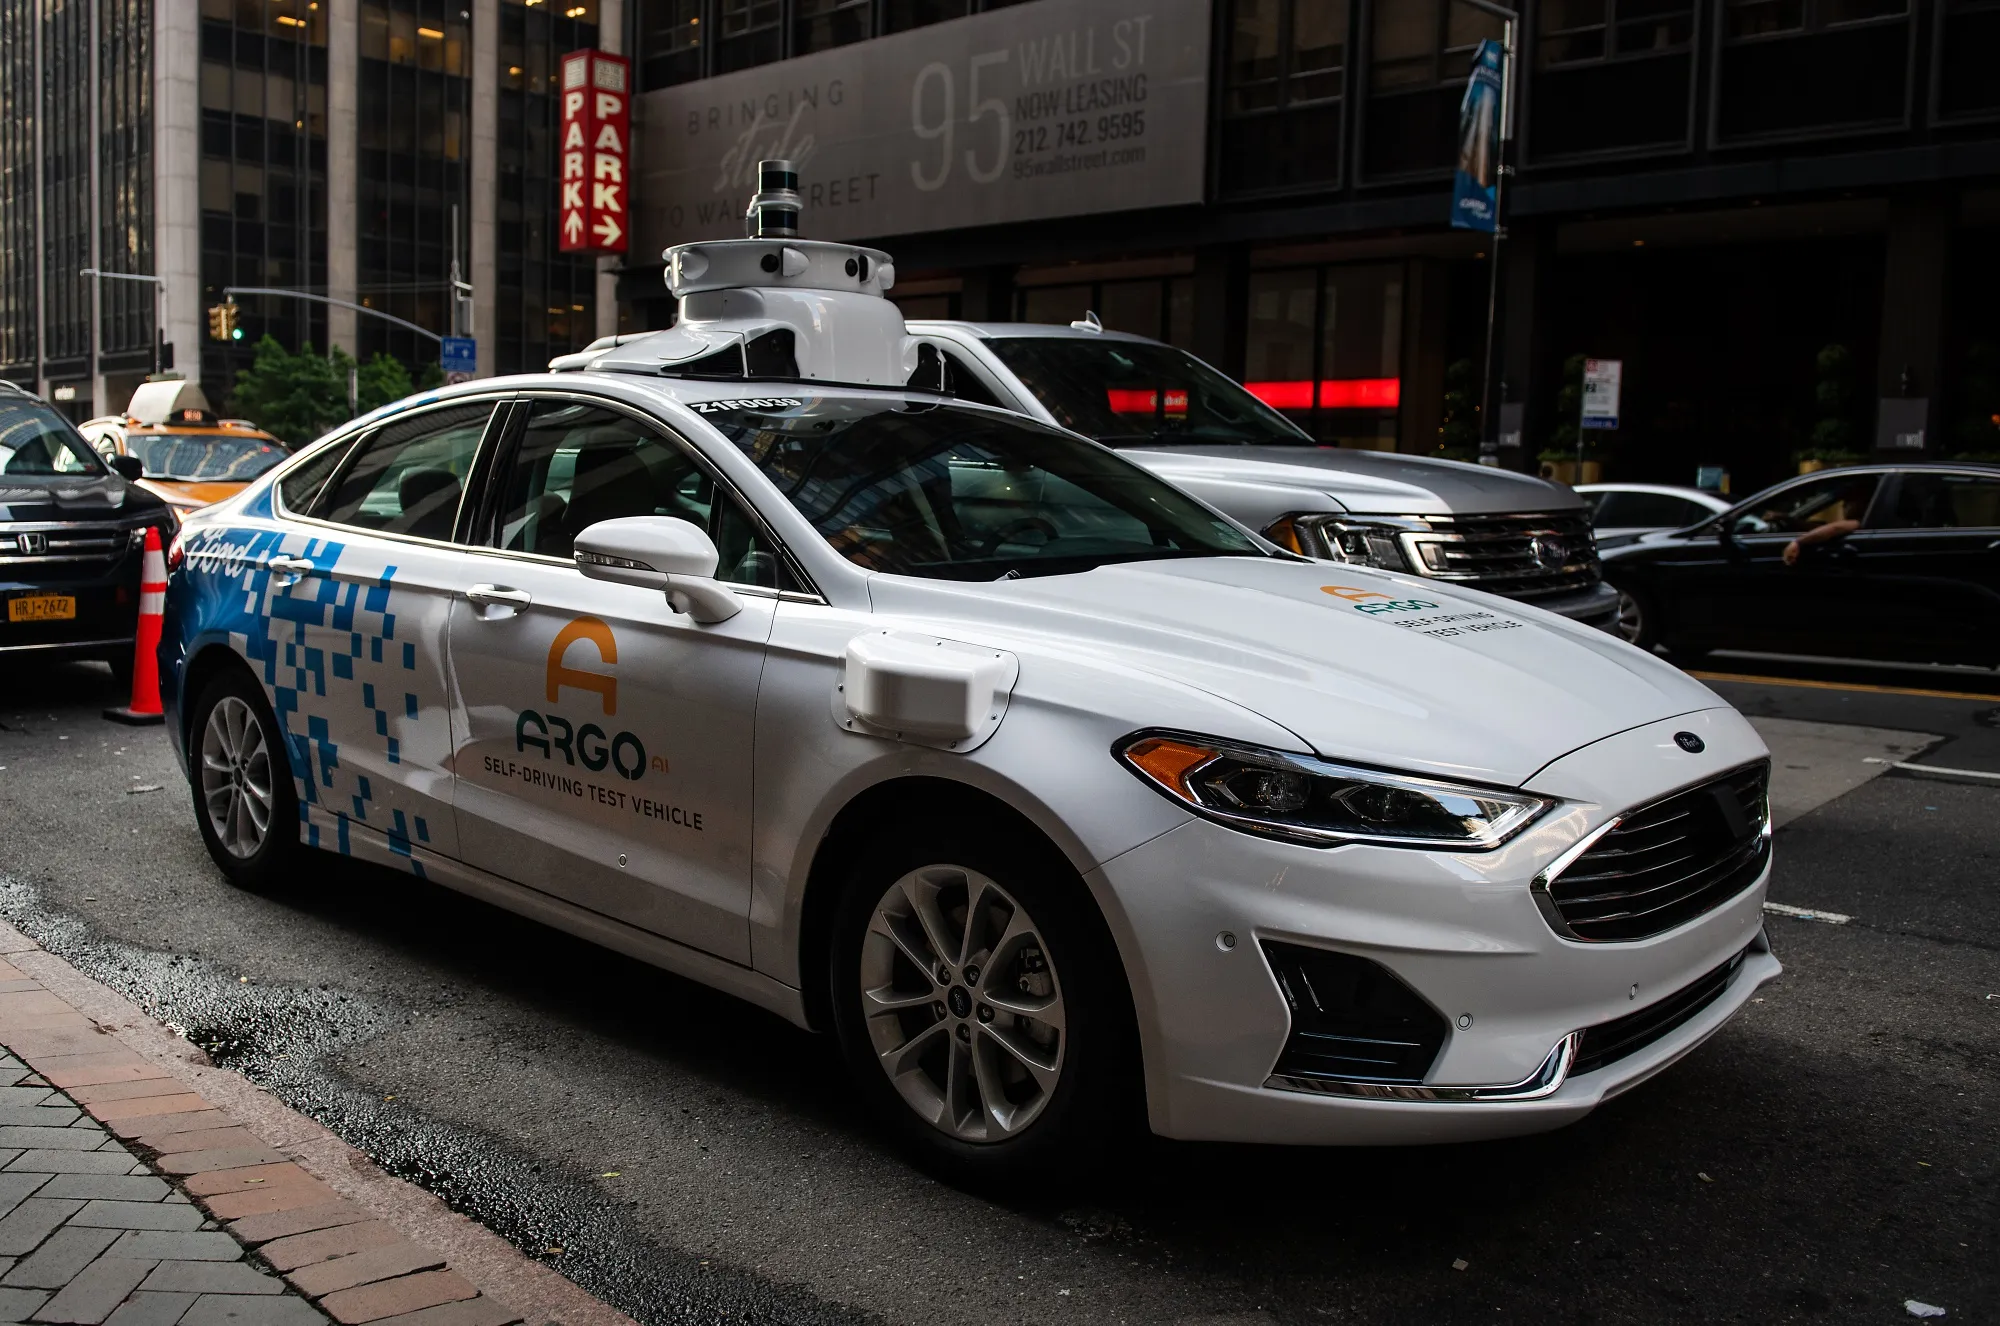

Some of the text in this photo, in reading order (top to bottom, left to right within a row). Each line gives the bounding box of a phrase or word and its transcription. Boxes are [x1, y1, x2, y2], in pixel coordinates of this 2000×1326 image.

[1018, 14, 1153, 88] WALL ST
[688, 80, 844, 135] BRINGING
[910, 49, 1011, 191] 95
[1015, 73, 1148, 122] NOW LEASING
[563, 91, 585, 210] PARK
[593, 93, 623, 213] PARK
[699, 199, 749, 225] WAL
[186, 528, 262, 578] Ford
[1353, 599, 1440, 616] ARGO
[1394, 611, 1495, 629] SELF-DRIVING
[1423, 620, 1523, 638] TEST VEHICLE
[516, 709, 670, 781] ARGO AI
[484, 756, 704, 832] SELF-DRIVING TEST VEHICLE
